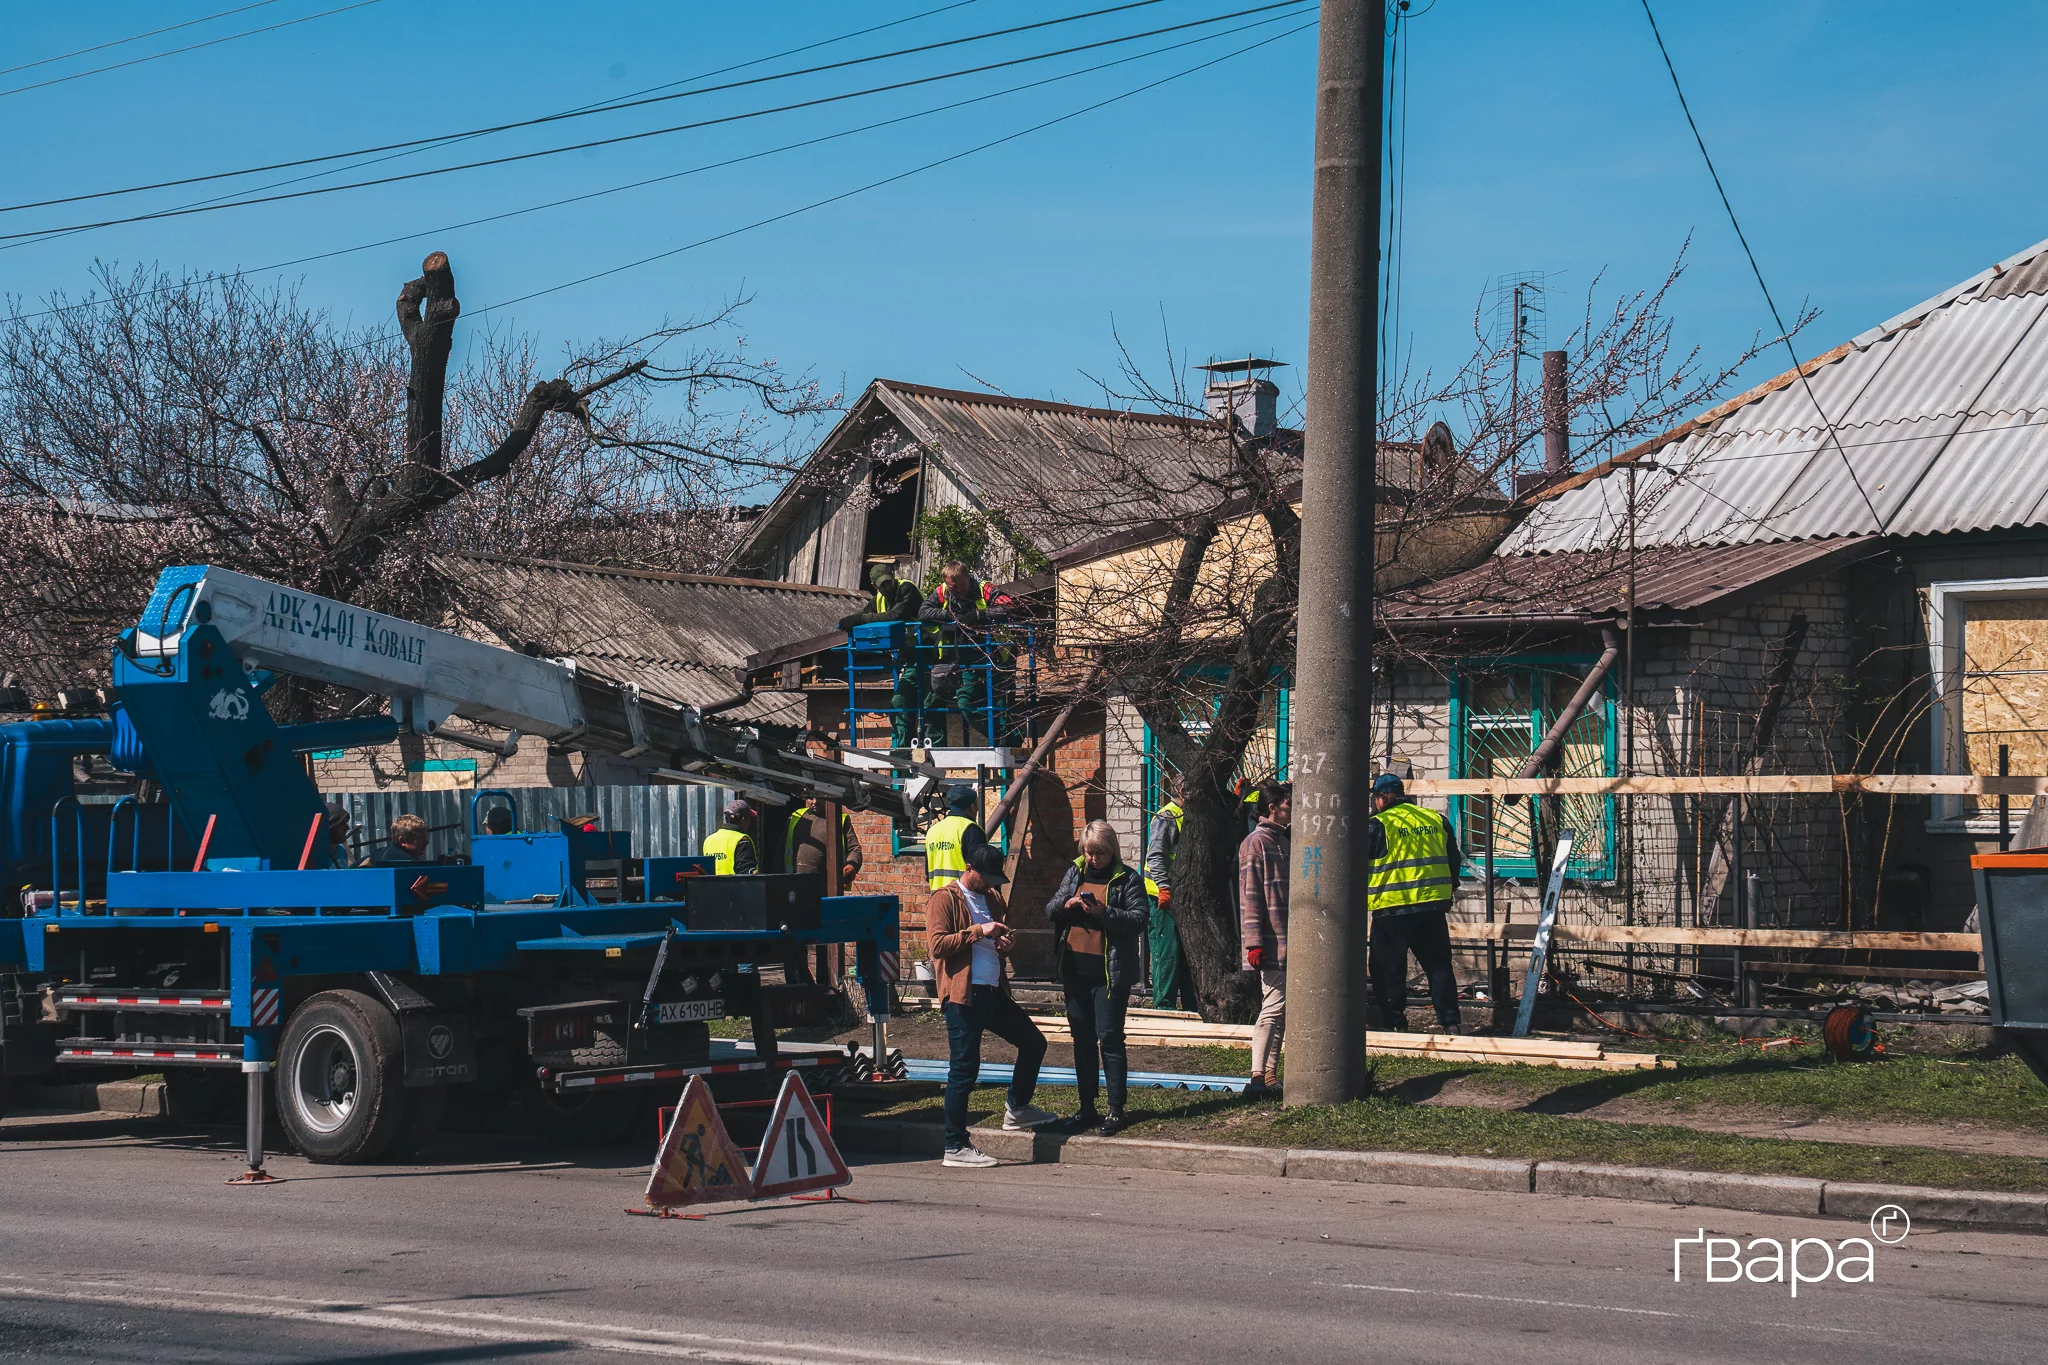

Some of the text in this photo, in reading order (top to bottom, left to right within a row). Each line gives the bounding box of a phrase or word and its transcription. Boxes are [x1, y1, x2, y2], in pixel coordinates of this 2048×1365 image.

[263, 590, 354, 648] APK-24-01
[1300, 814, 1350, 838] 1975
[661, 1004, 677, 1020] AX
[680, 1002, 706, 1018] 6190
